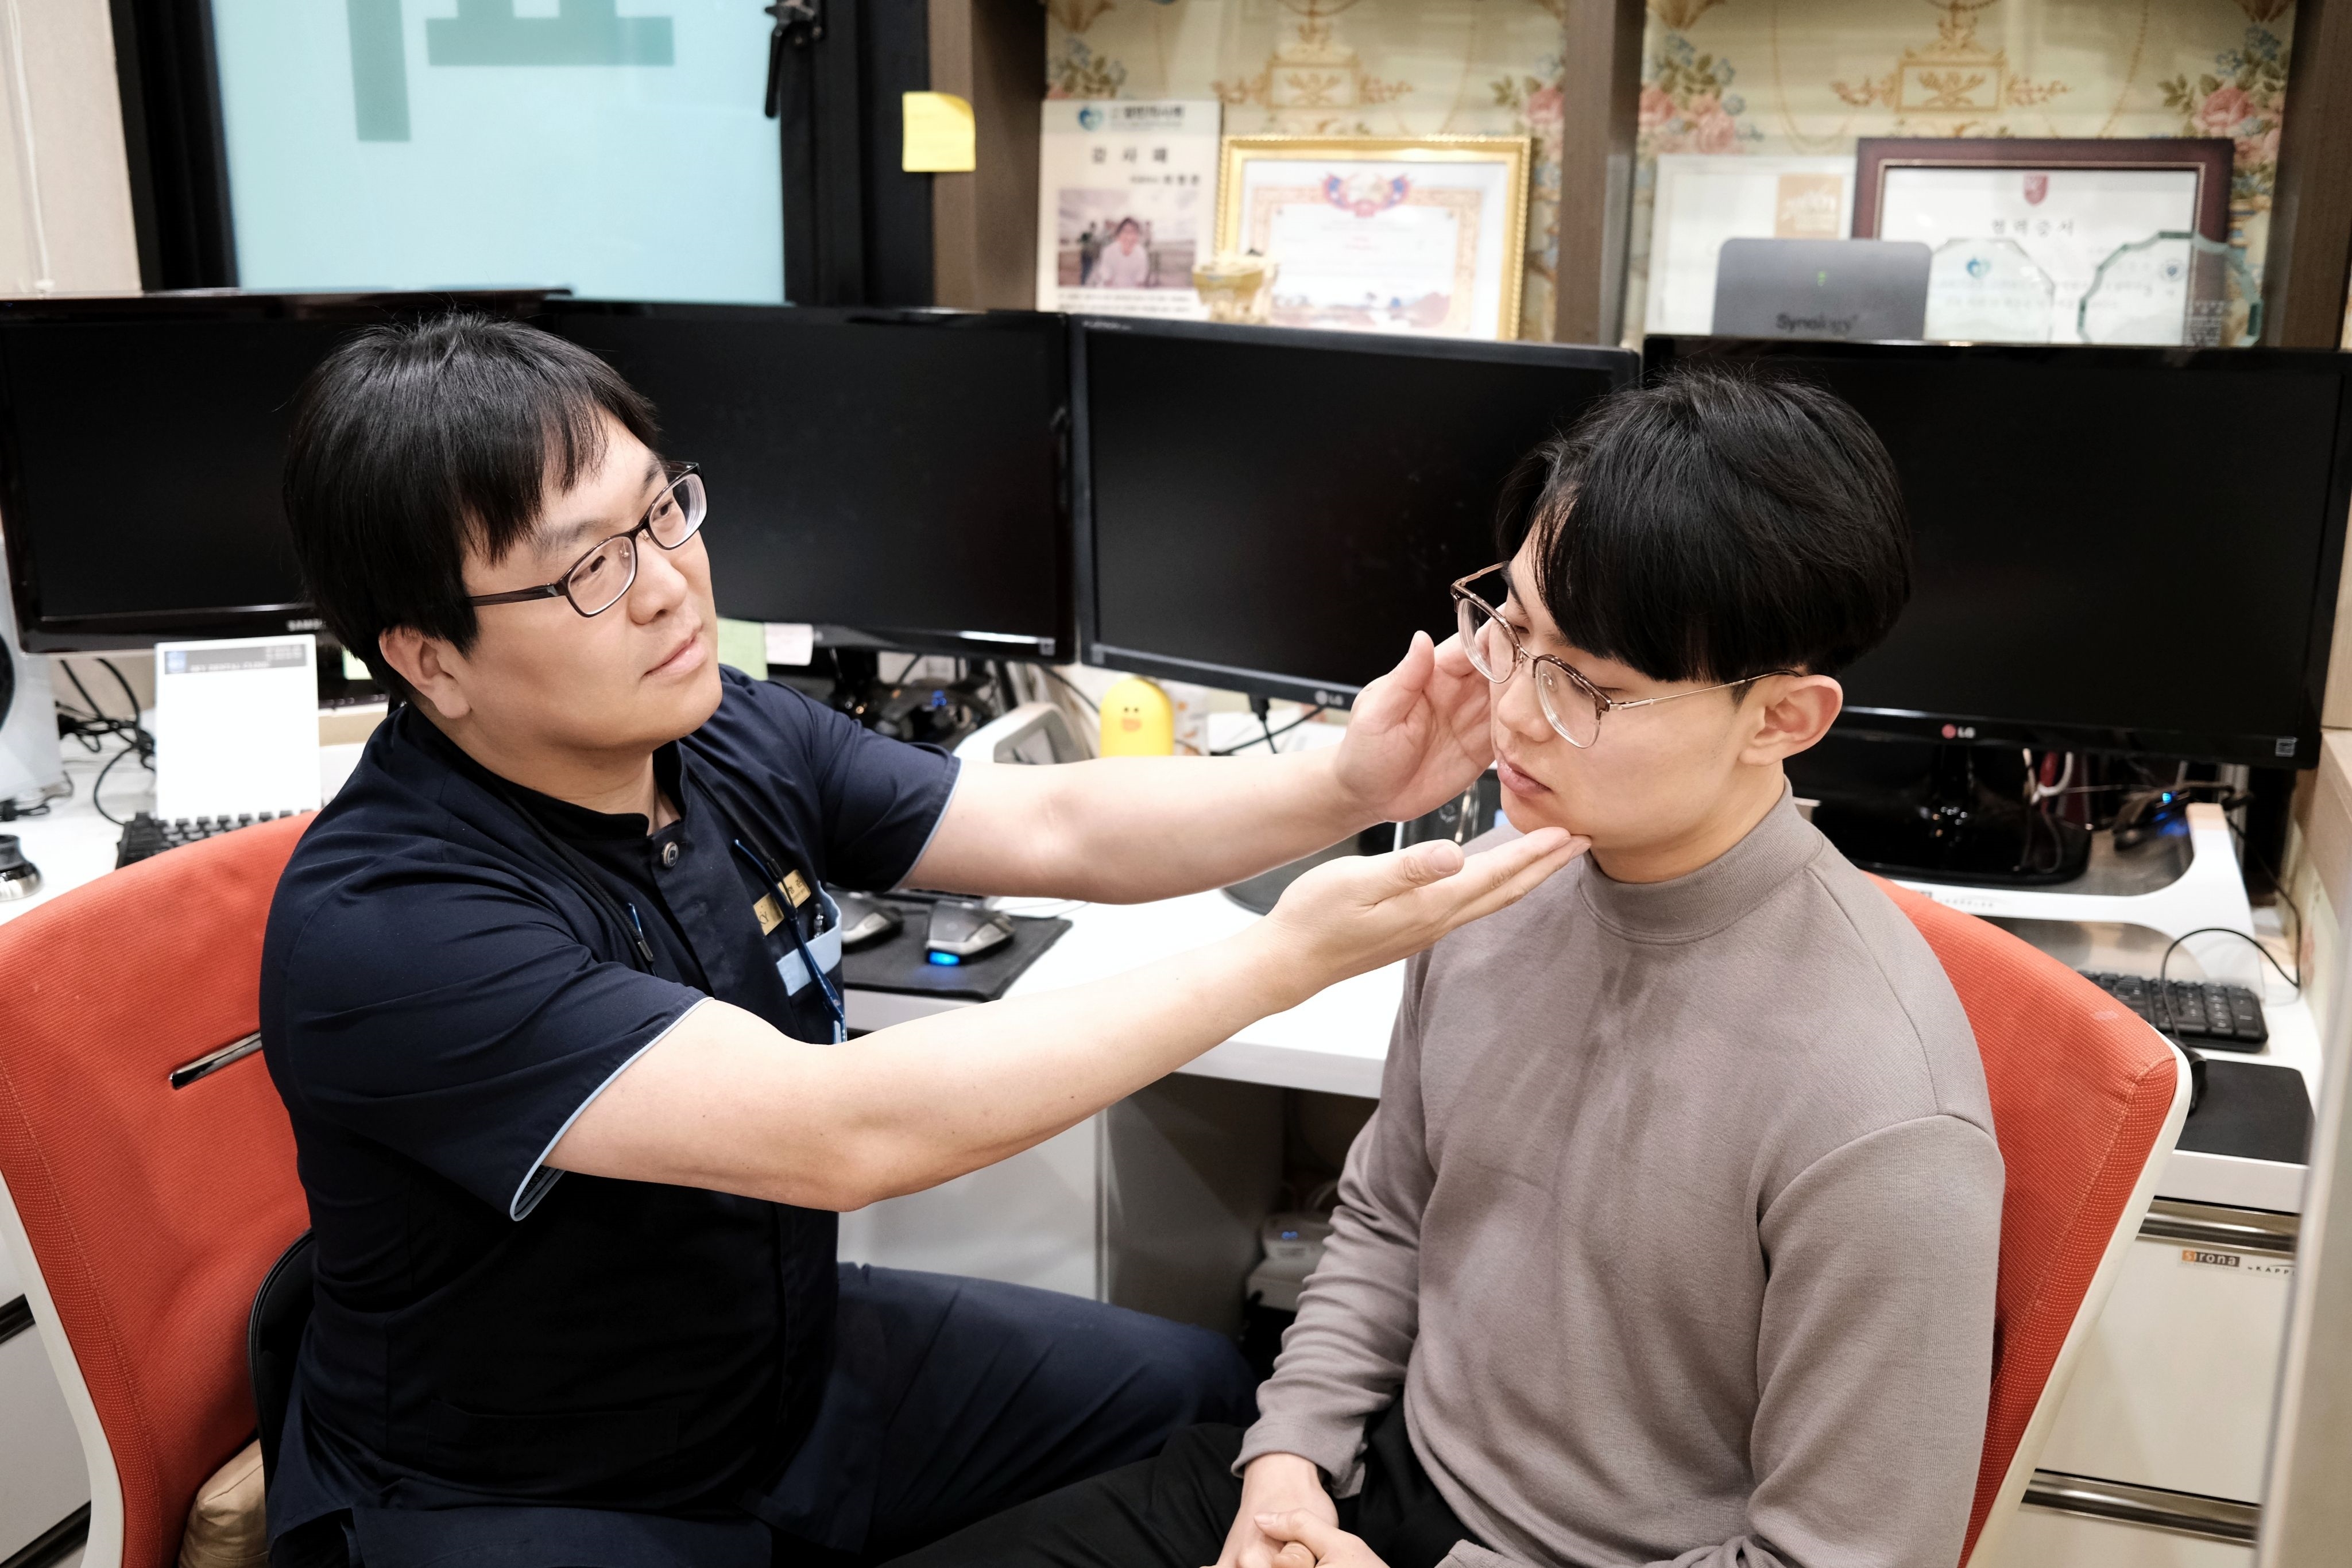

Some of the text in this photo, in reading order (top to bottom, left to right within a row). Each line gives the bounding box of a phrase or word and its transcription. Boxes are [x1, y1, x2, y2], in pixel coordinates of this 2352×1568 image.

[287, 618, 323, 632] SAMS
[1957, 726, 1976, 739] LG
[2184, 1250, 2237, 1267] sirona
